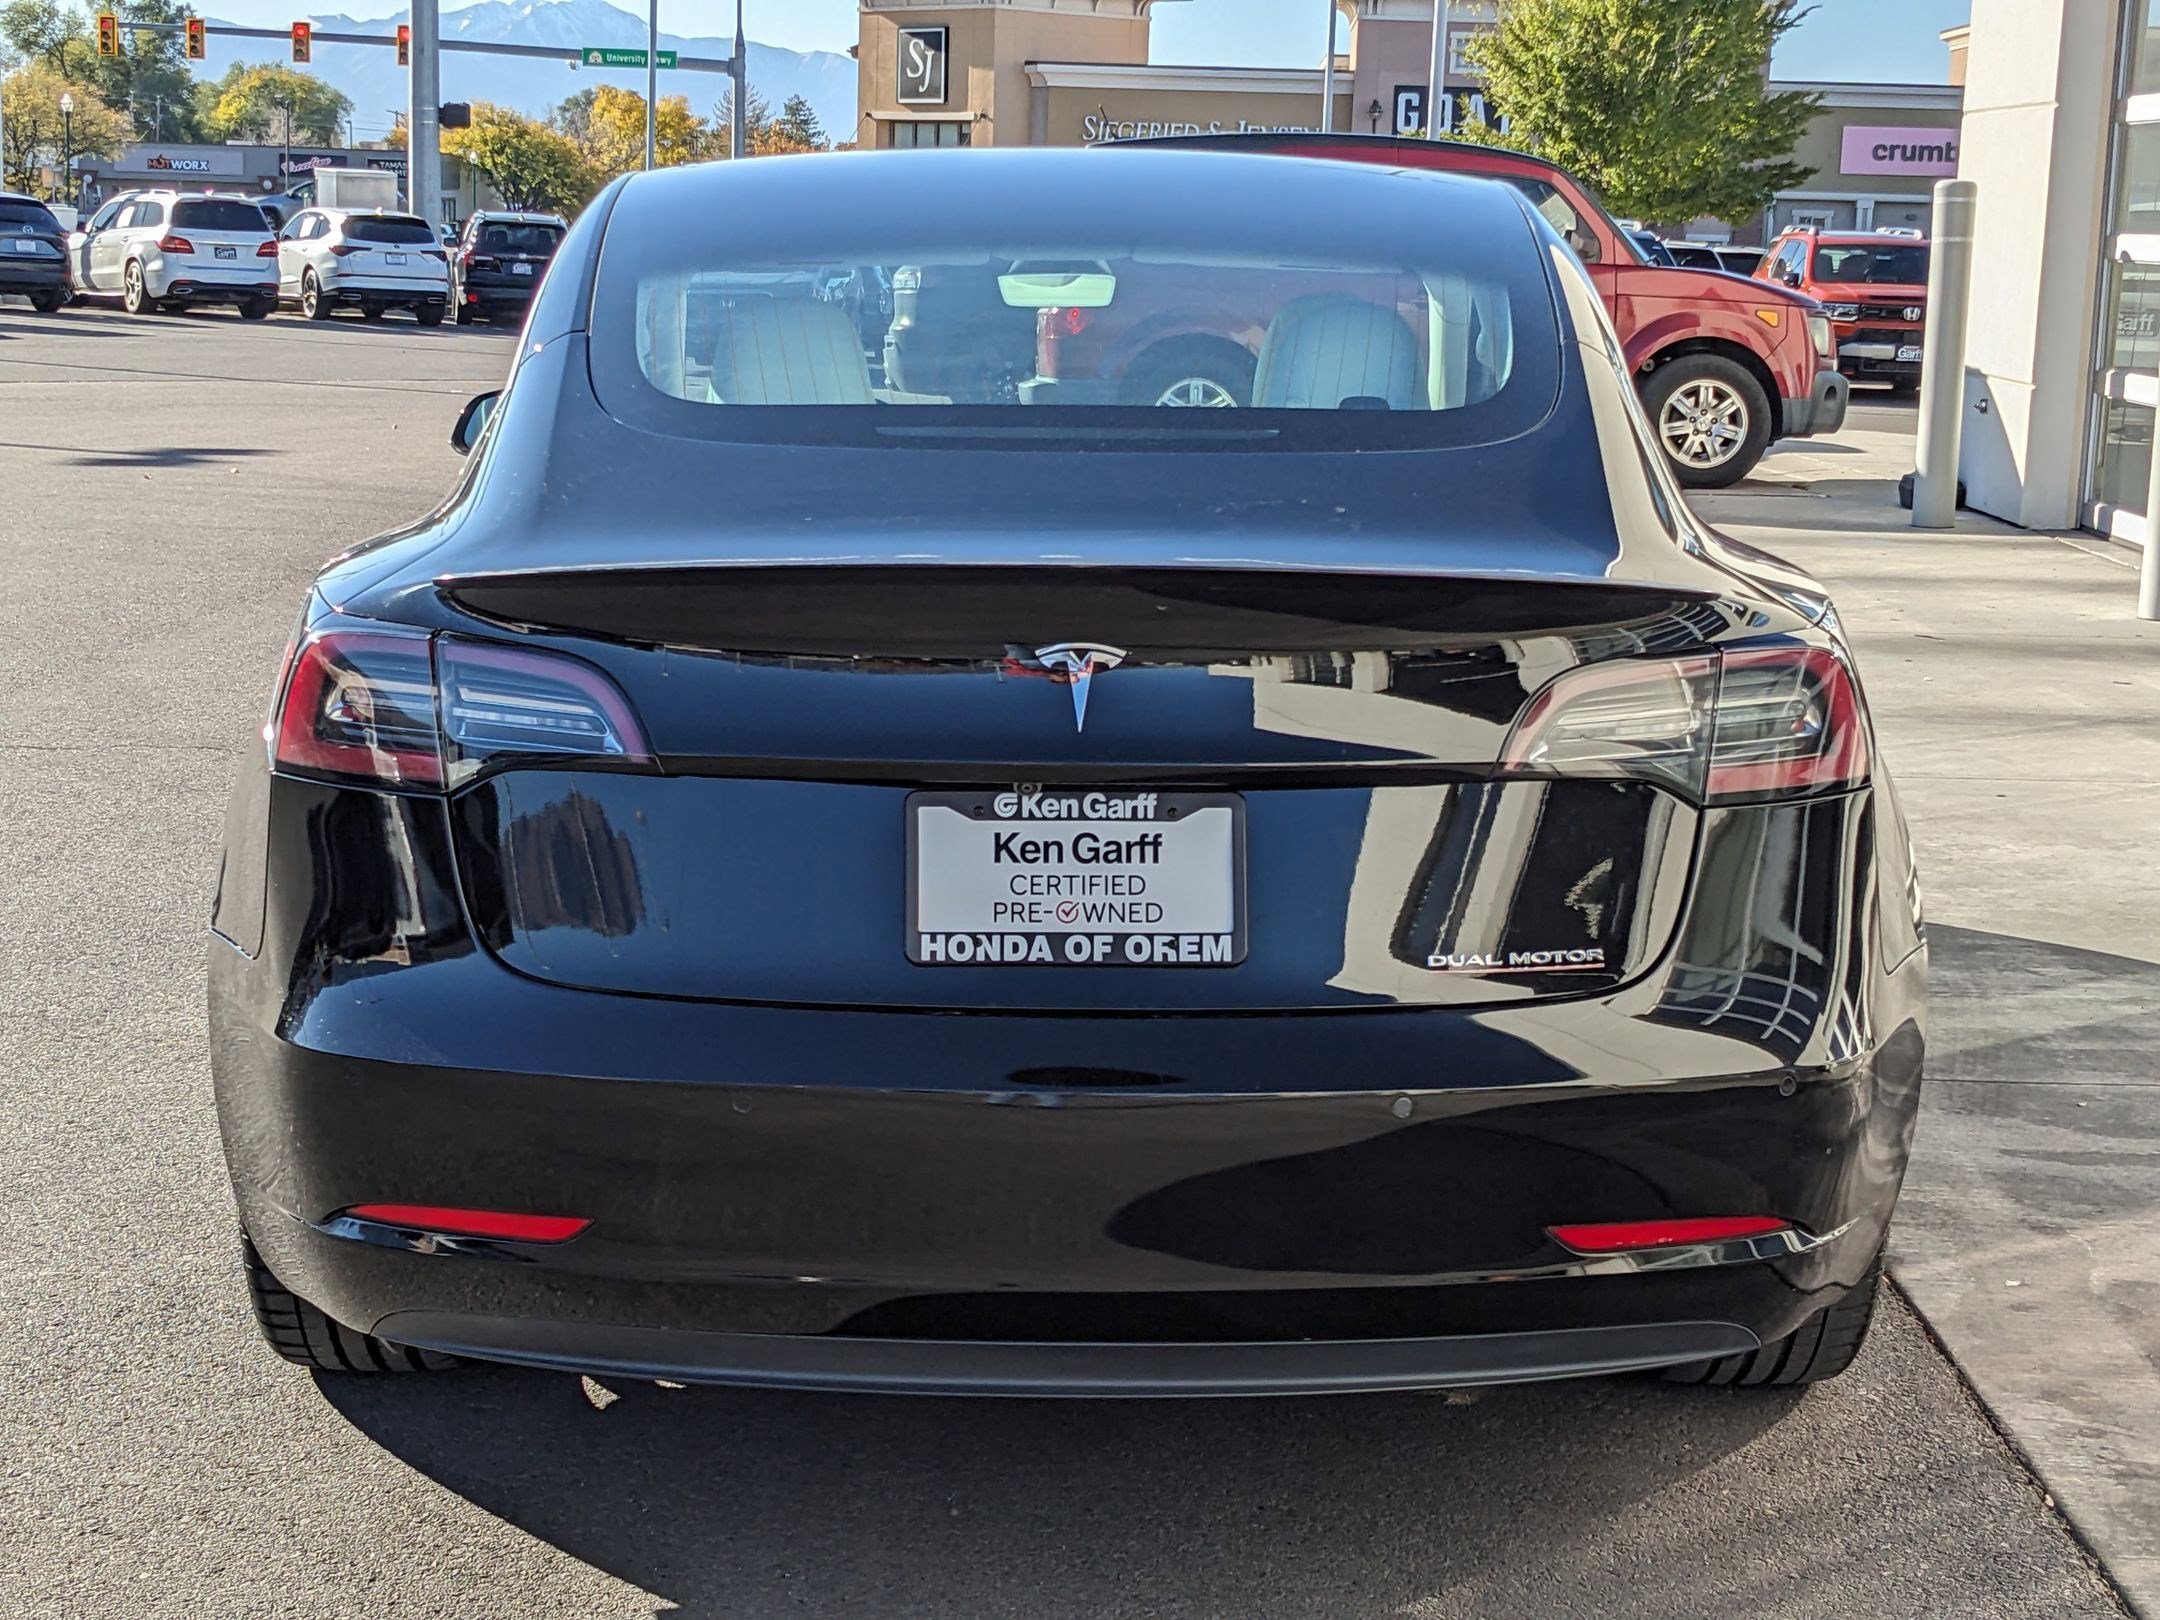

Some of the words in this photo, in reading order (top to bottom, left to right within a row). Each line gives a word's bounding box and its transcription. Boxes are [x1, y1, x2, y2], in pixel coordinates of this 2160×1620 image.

[606, 53, 646, 65] University
[905, 38, 934, 93] SJ
[1082, 115, 1200, 140] SIEGFRIED
[148, 156, 209, 171] HOTWORX
[1022, 793, 1079, 819] Ken
[1083, 793, 1158, 819] Garff
[994, 832, 1063, 864] Ken
[1072, 832, 1163, 864] Garff
[1010, 874, 1146, 896] CERTIFIED
[921, 935, 1053, 962] HONDA
[1065, 935, 1112, 962] OF
[1125, 935, 1232, 962] OREM
[1428, 953, 1502, 968] DUAL
[1509, 948, 1605, 966] MOTOR
